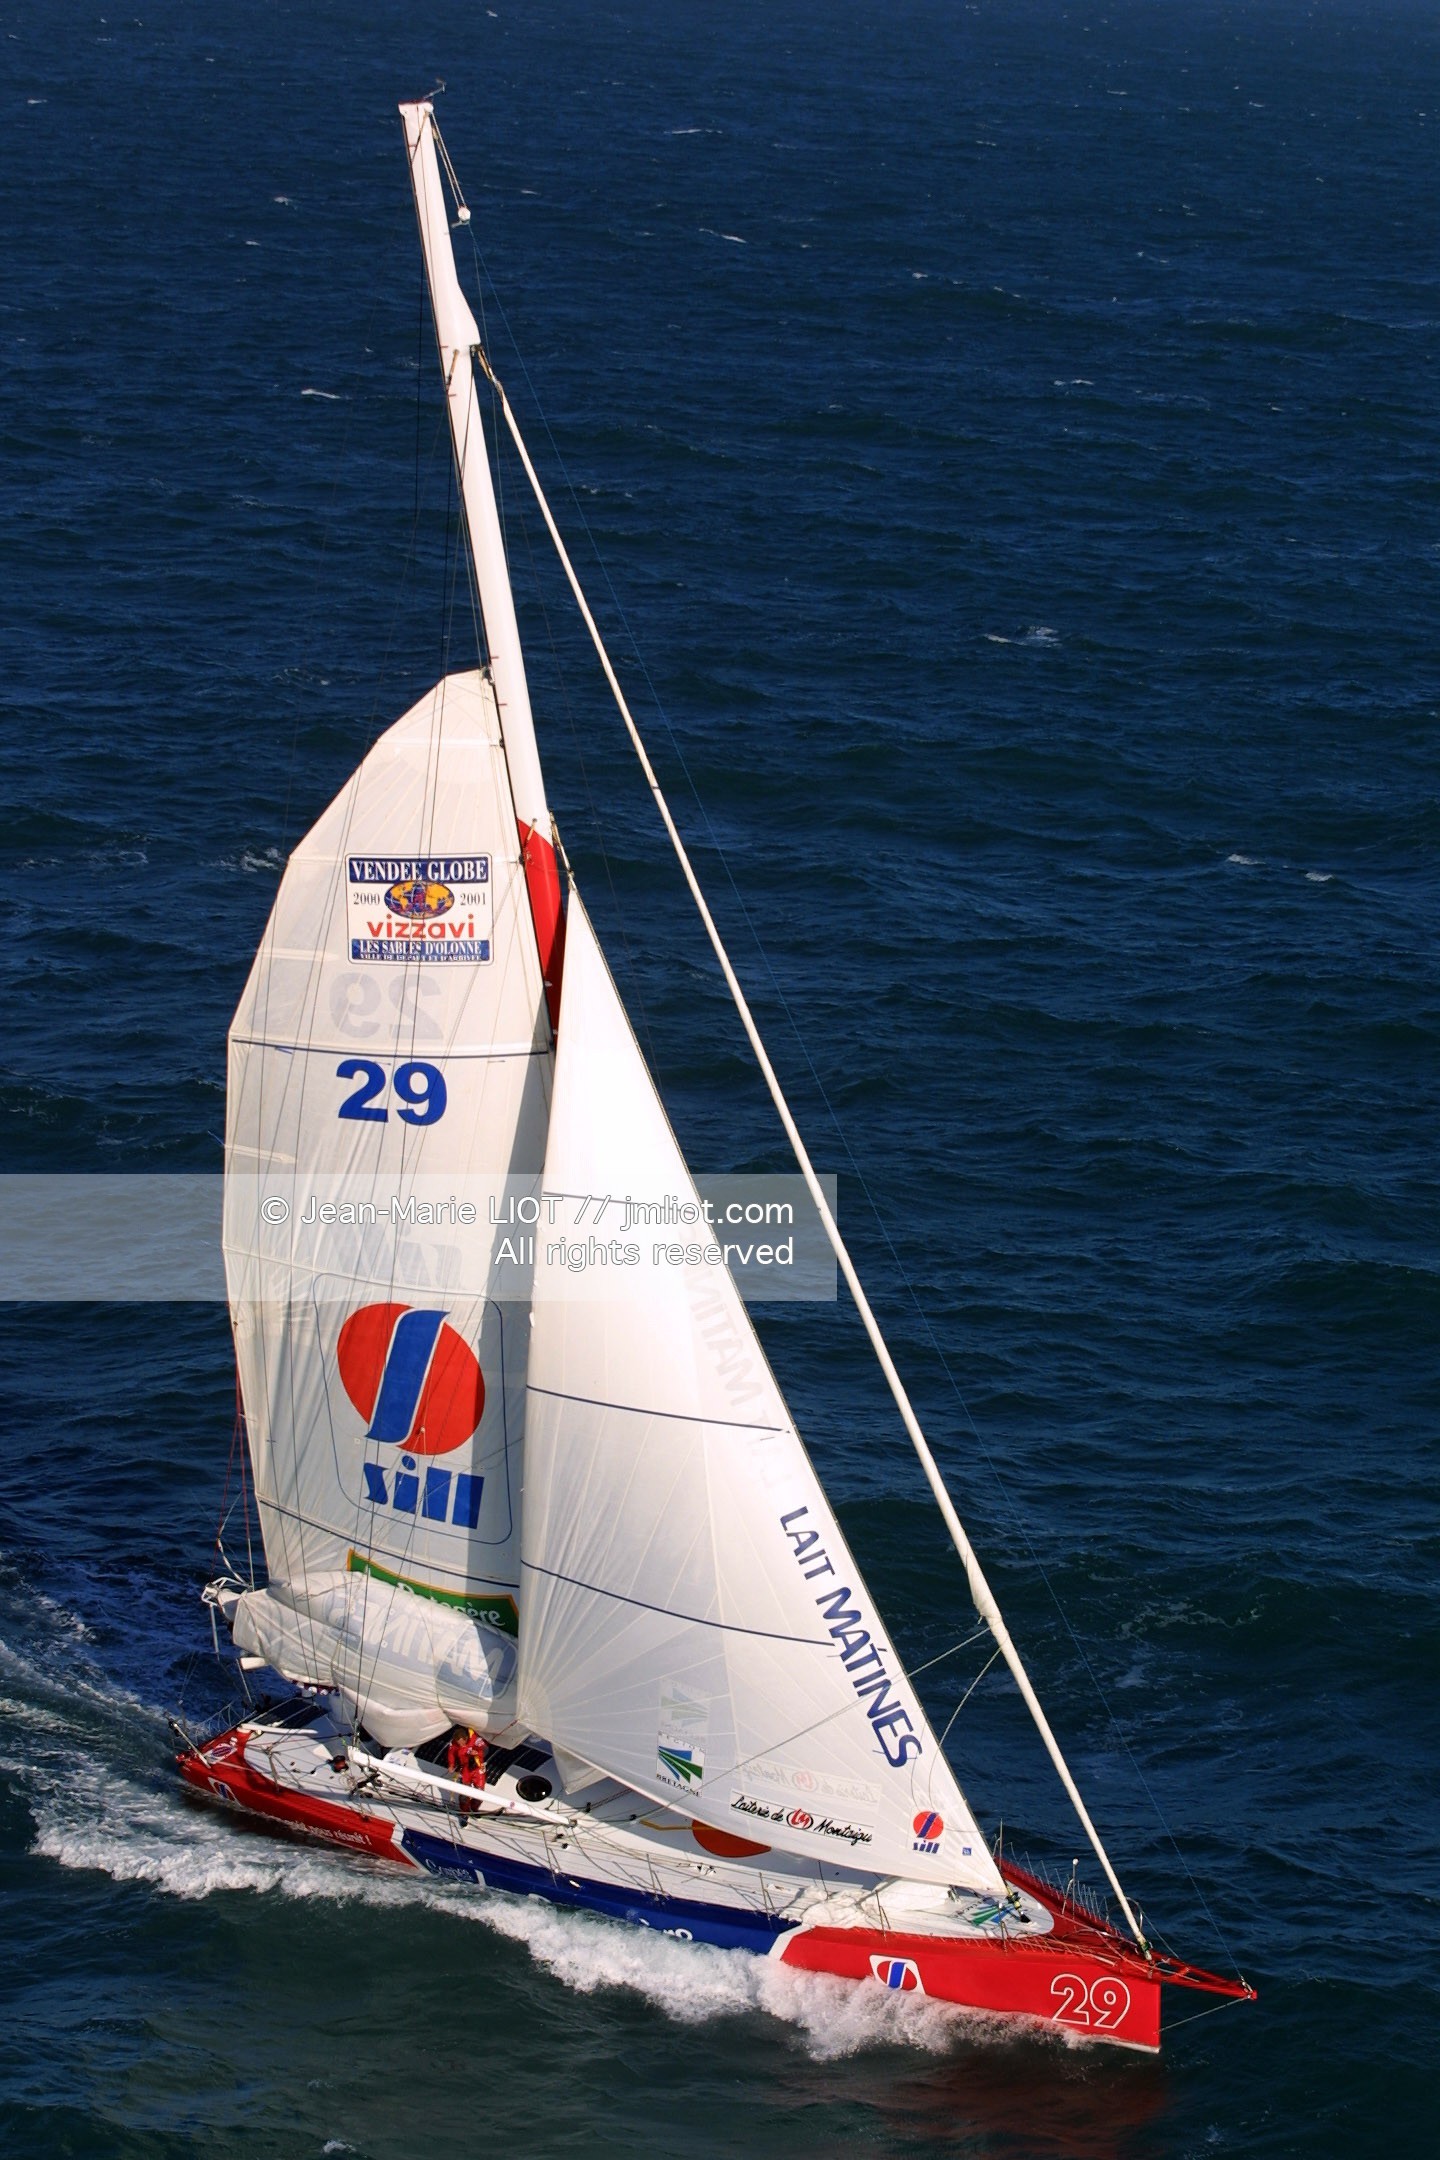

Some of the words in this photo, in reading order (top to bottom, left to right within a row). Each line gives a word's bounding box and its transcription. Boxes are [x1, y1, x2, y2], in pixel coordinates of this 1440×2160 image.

[352, 861, 422, 881] VENDEE
[427, 860, 486, 881] GLOBE
[353, 892, 380, 905] 2000
[460, 892, 486, 905] 2001
[367, 913, 474, 938] vizzavi
[360, 940, 379, 953] LES
[382, 940, 421, 954] SABLES
[426, 940, 481, 955] D'OLONNE
[336, 1058, 447, 1126] 29
[363, 1455, 485, 1530] sill
[779, 1505, 835, 1580] LAIT
[816, 1586, 922, 1768] MATINES
[656, 1773, 703, 1798] BRETAGNE
[731, 1795, 770, 1818] Laiterie
[770, 1808, 784, 1822] de
[813, 1818, 873, 1846] Montaigu
[1050, 1973, 1131, 2029] 29
